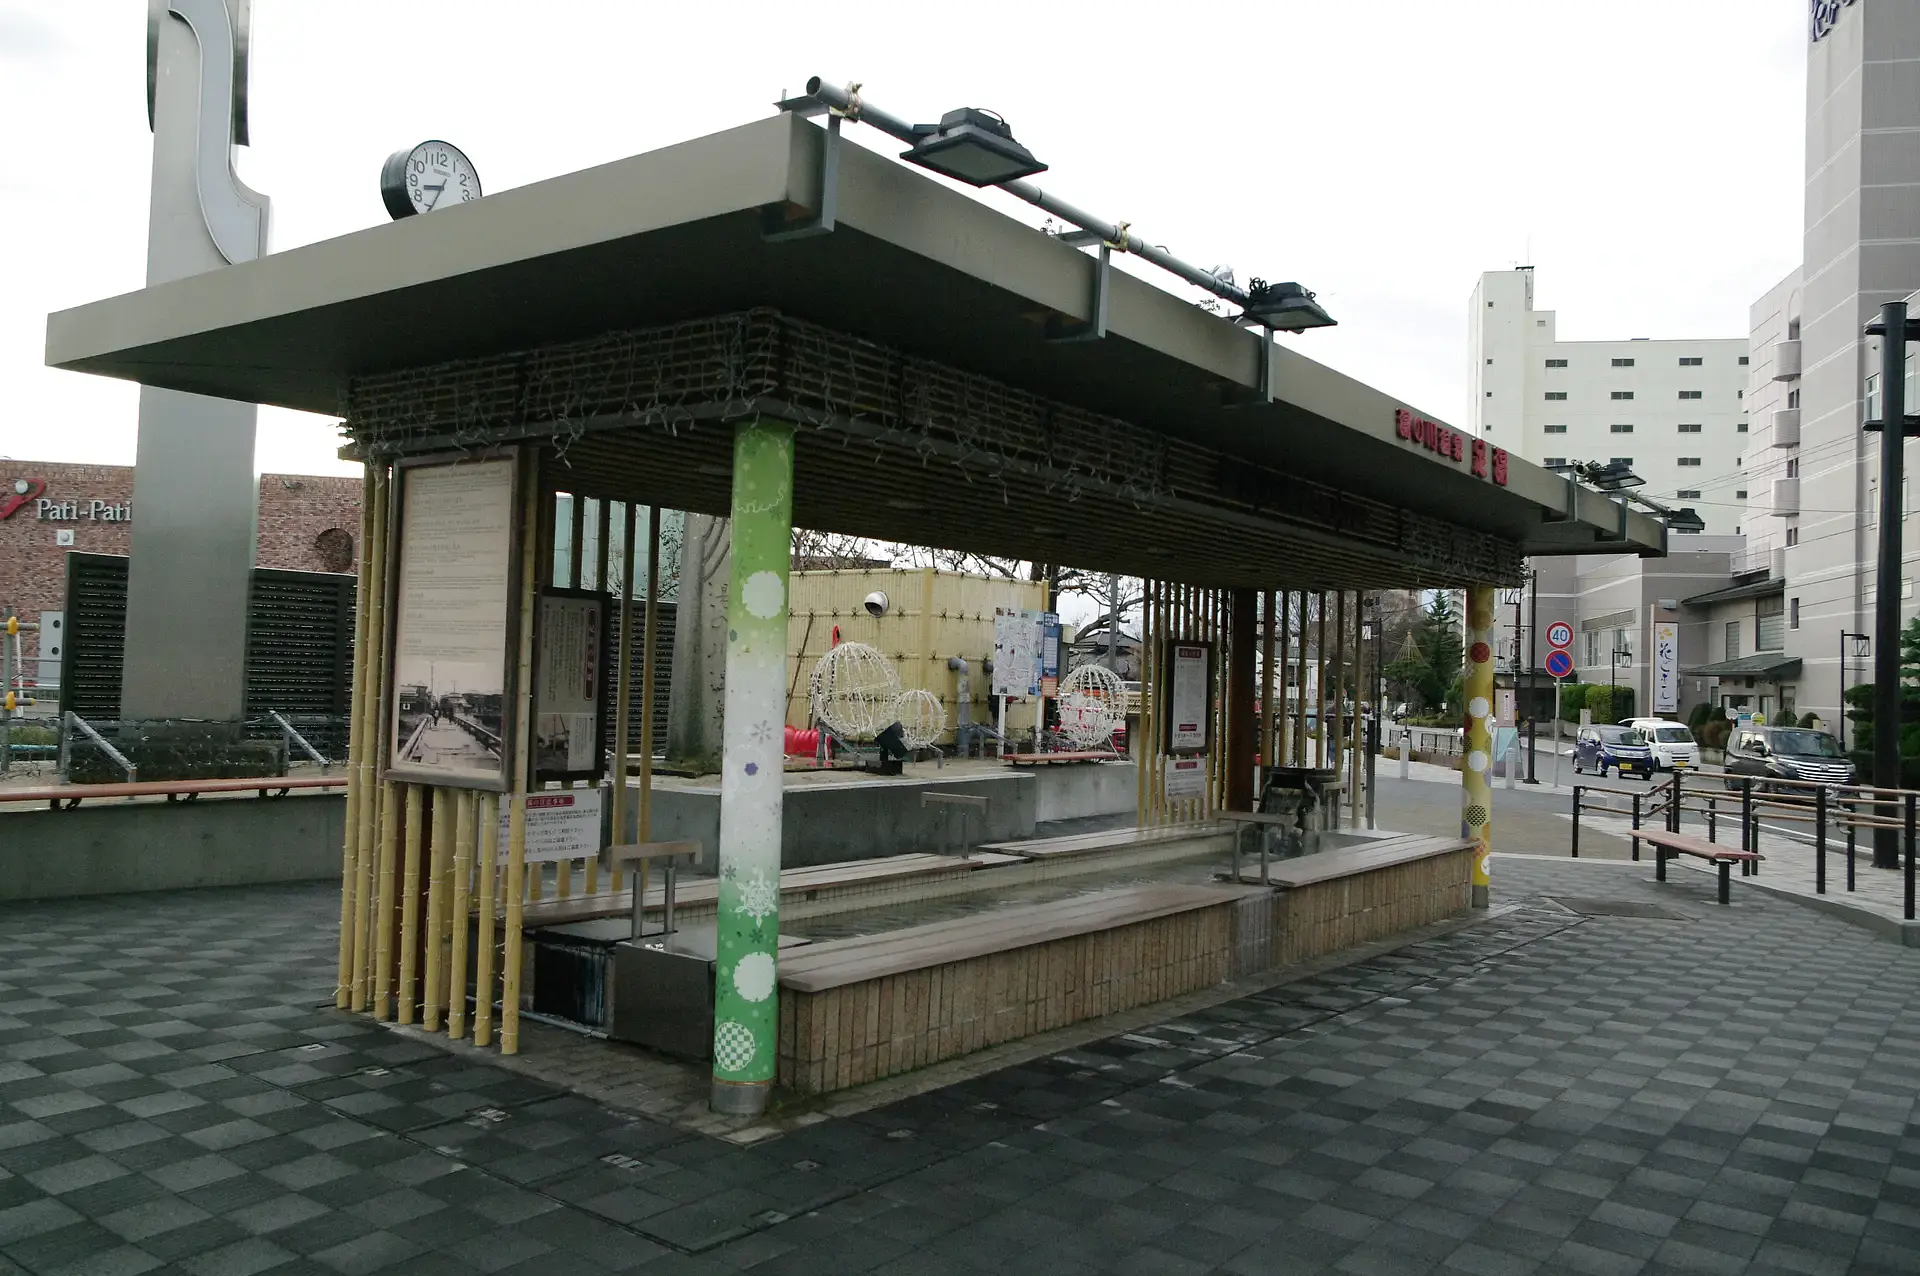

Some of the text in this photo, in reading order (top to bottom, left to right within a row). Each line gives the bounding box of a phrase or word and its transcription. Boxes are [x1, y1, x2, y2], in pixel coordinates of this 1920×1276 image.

[436, 151, 448, 167] 12
[413, 160, 425, 174] 10
[409, 174, 419, 187] 9
[459, 173, 468, 187] 2
[413, 189, 423, 203] 8
[36, 498, 132, 522] Pati-Pati
[1552, 629, 1568, 642] 40
